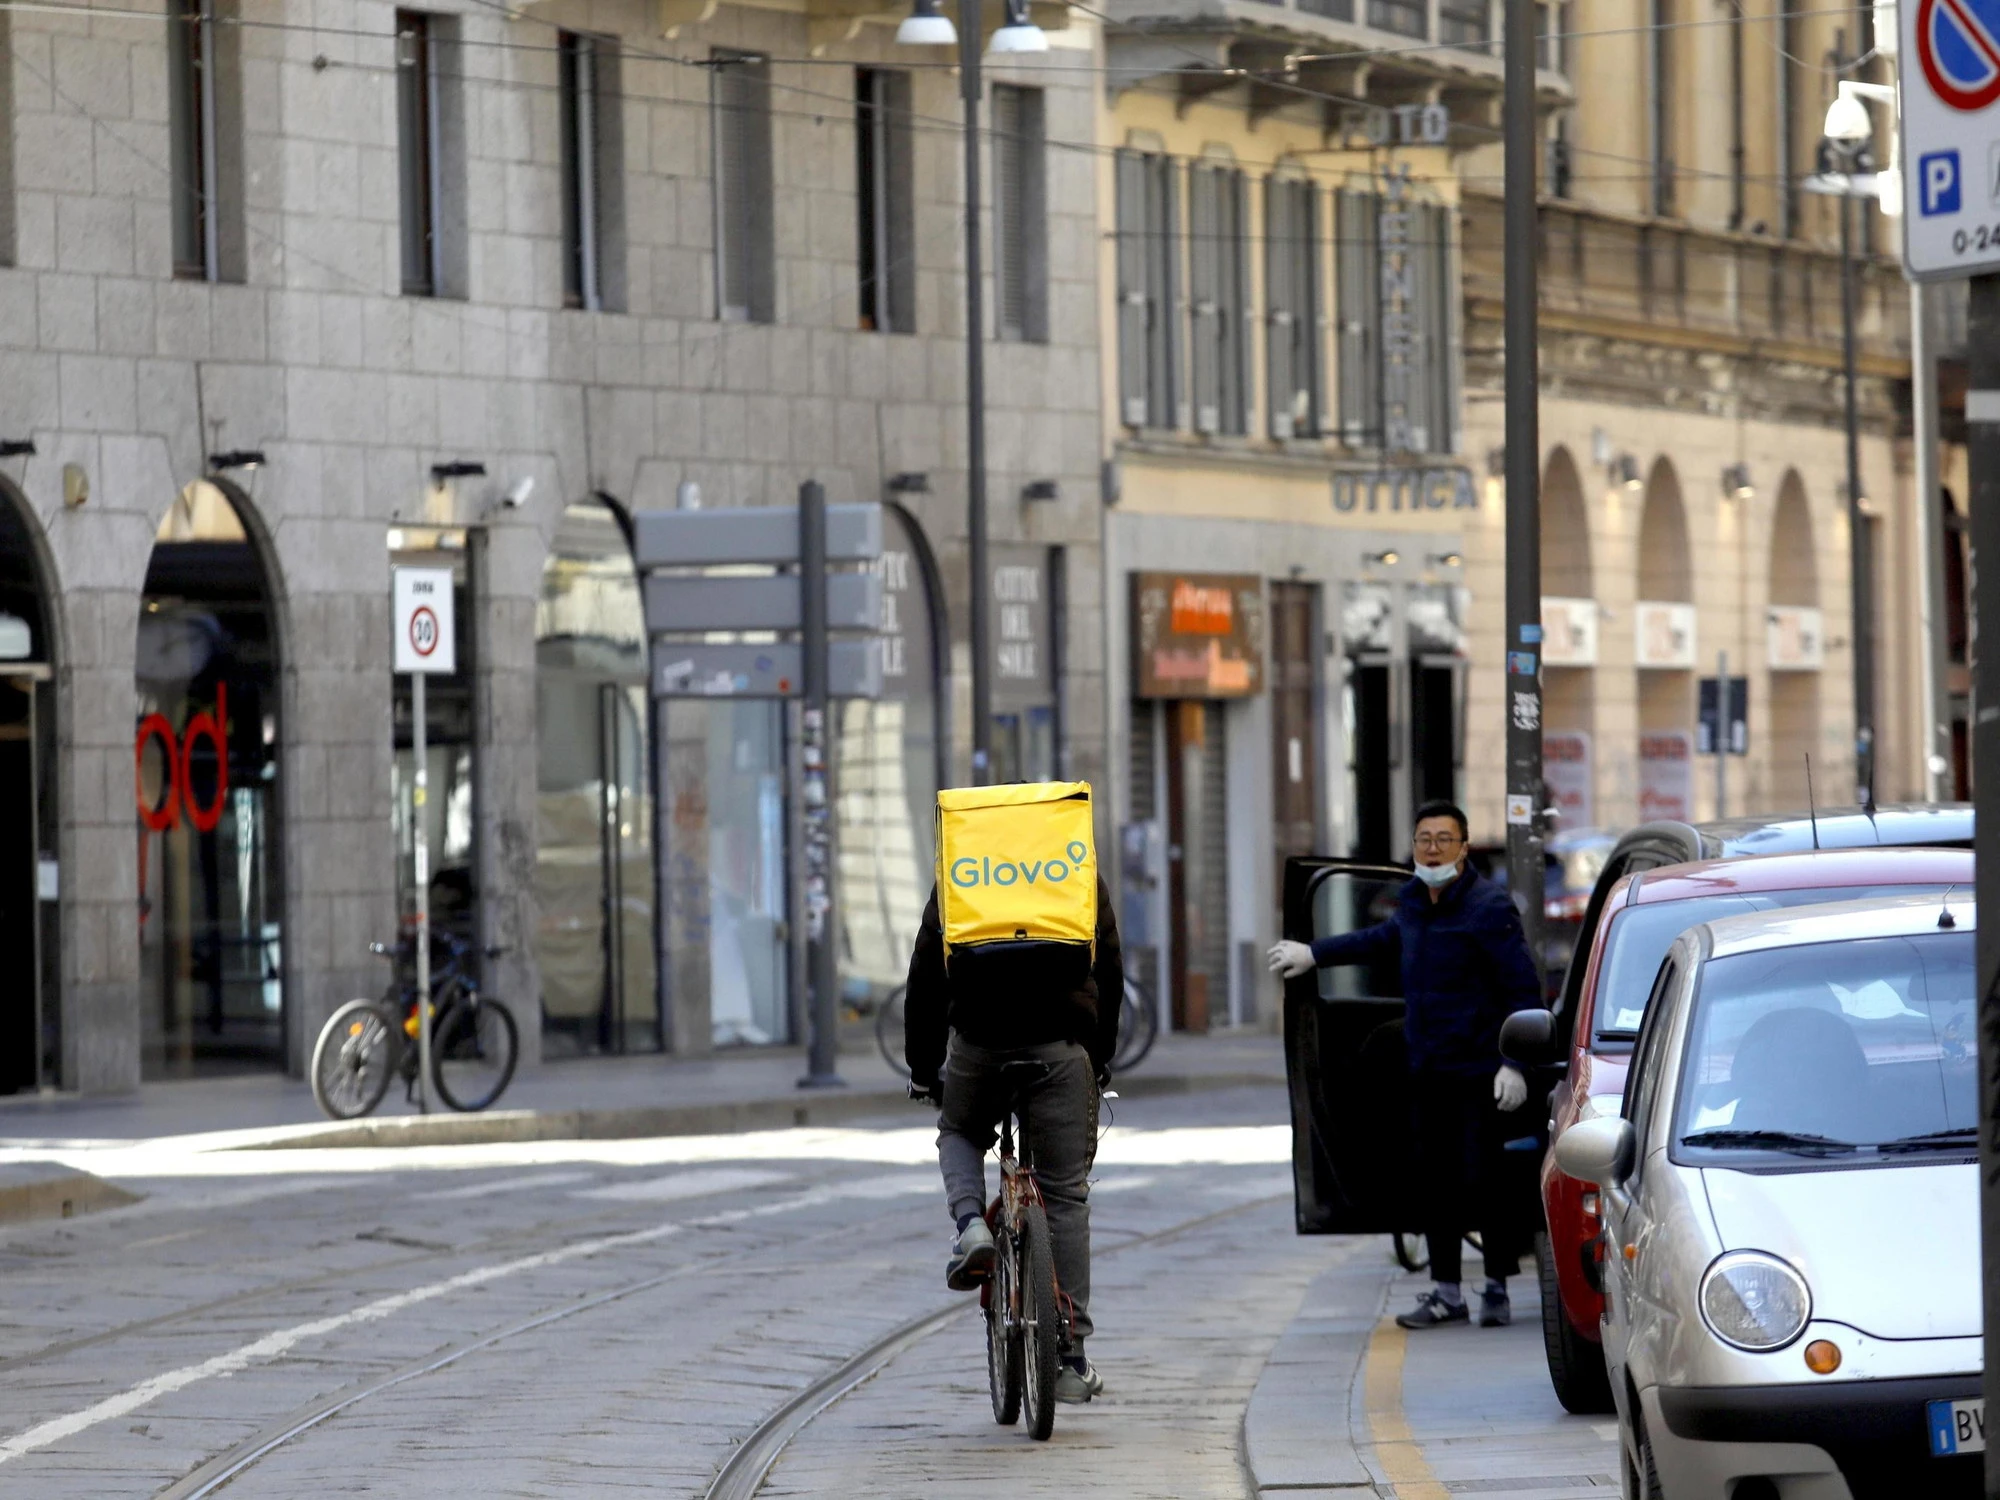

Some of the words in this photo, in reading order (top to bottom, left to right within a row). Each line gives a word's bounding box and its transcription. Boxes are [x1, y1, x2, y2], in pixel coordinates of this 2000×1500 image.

[1340, 104, 1448, 147] FOTO
[1332, 470, 1477, 512] OTTICA
[415, 620, 433, 642] 30
[951, 856, 1069, 888] Glovo
